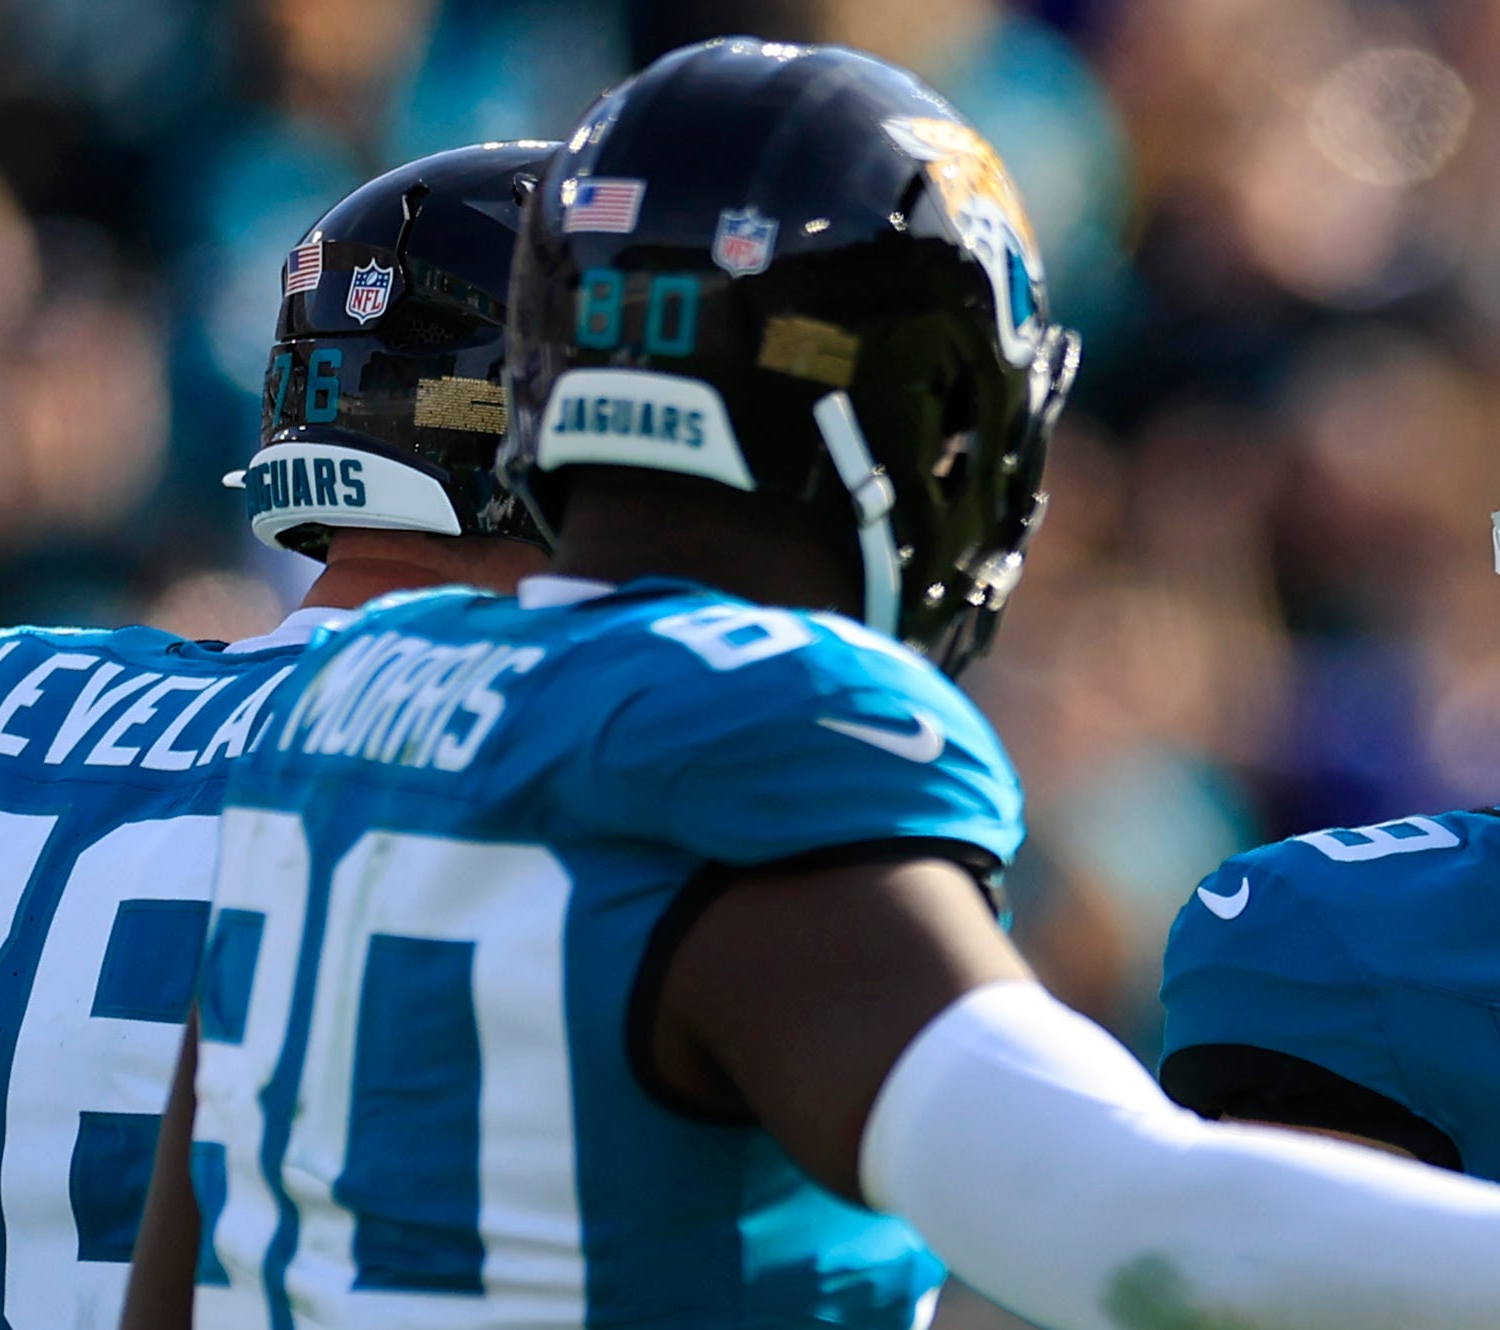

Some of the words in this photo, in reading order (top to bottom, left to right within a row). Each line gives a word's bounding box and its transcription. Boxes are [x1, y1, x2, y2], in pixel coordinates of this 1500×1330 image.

[576, 268, 700, 358] 80
[271, 348, 345, 428] 76
[554, 397, 706, 449] JAGUARS
[242, 458, 366, 518] GUARS
[277, 630, 546, 772] MORRIS
